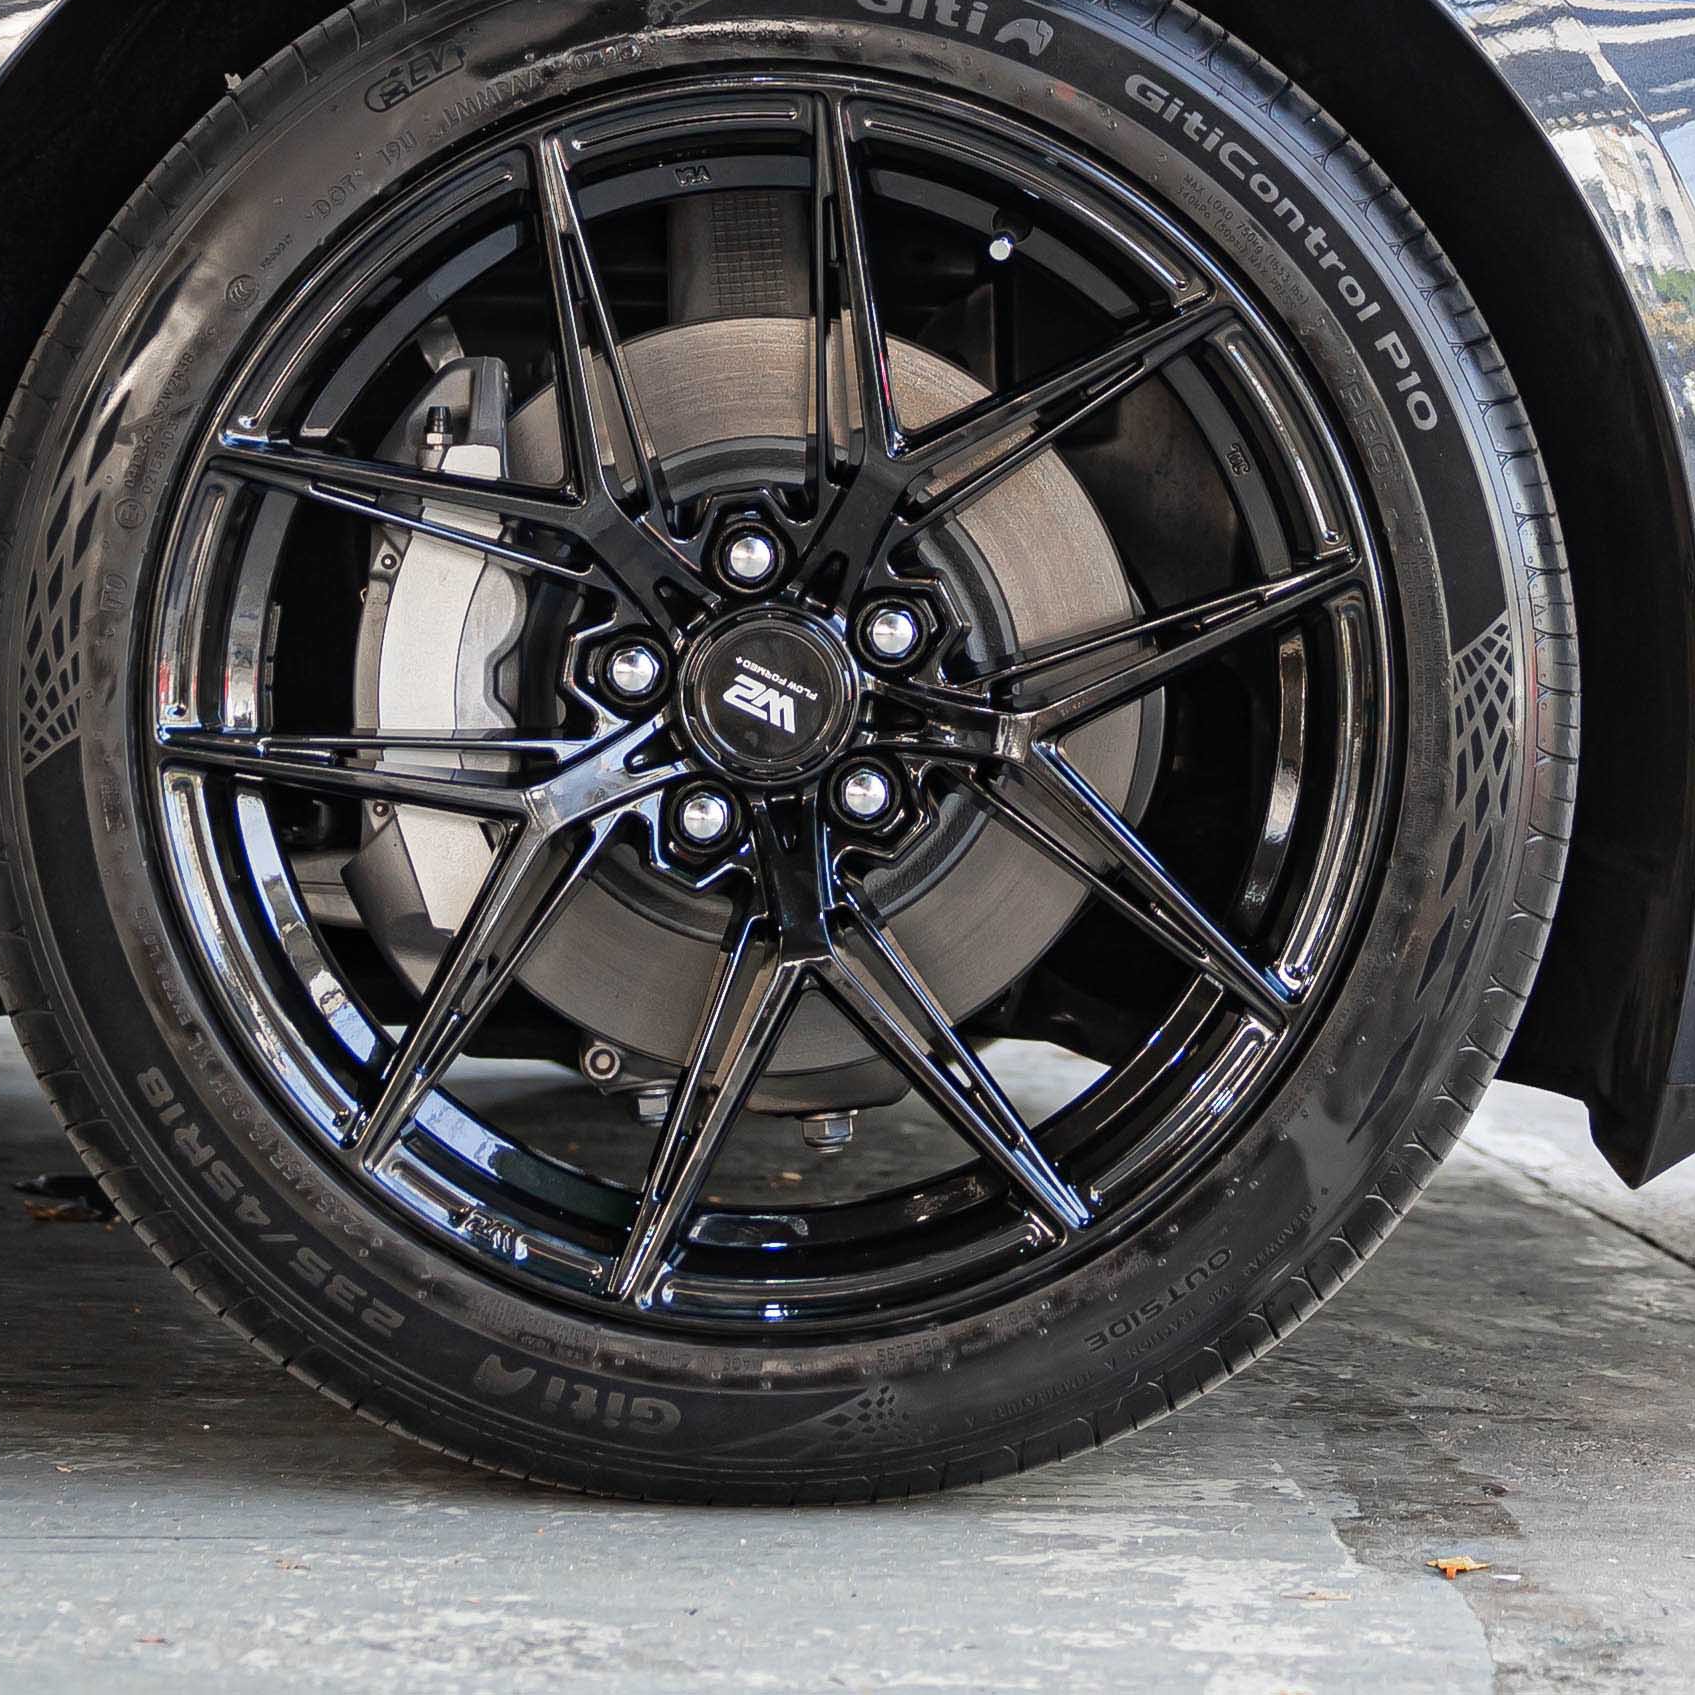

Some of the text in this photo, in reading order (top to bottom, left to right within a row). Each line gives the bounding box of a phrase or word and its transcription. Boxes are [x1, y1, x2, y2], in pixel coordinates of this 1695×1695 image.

[1119, 68, 1440, 436] GitiControl P10
[723, 673, 796, 735] W2
[787, 680, 819, 701] FLOW
[128, 1062, 407, 1336] 235/45R18
[1080, 1243, 1237, 1353] OUTSIDE
[539, 1375, 683, 1435] Giti
